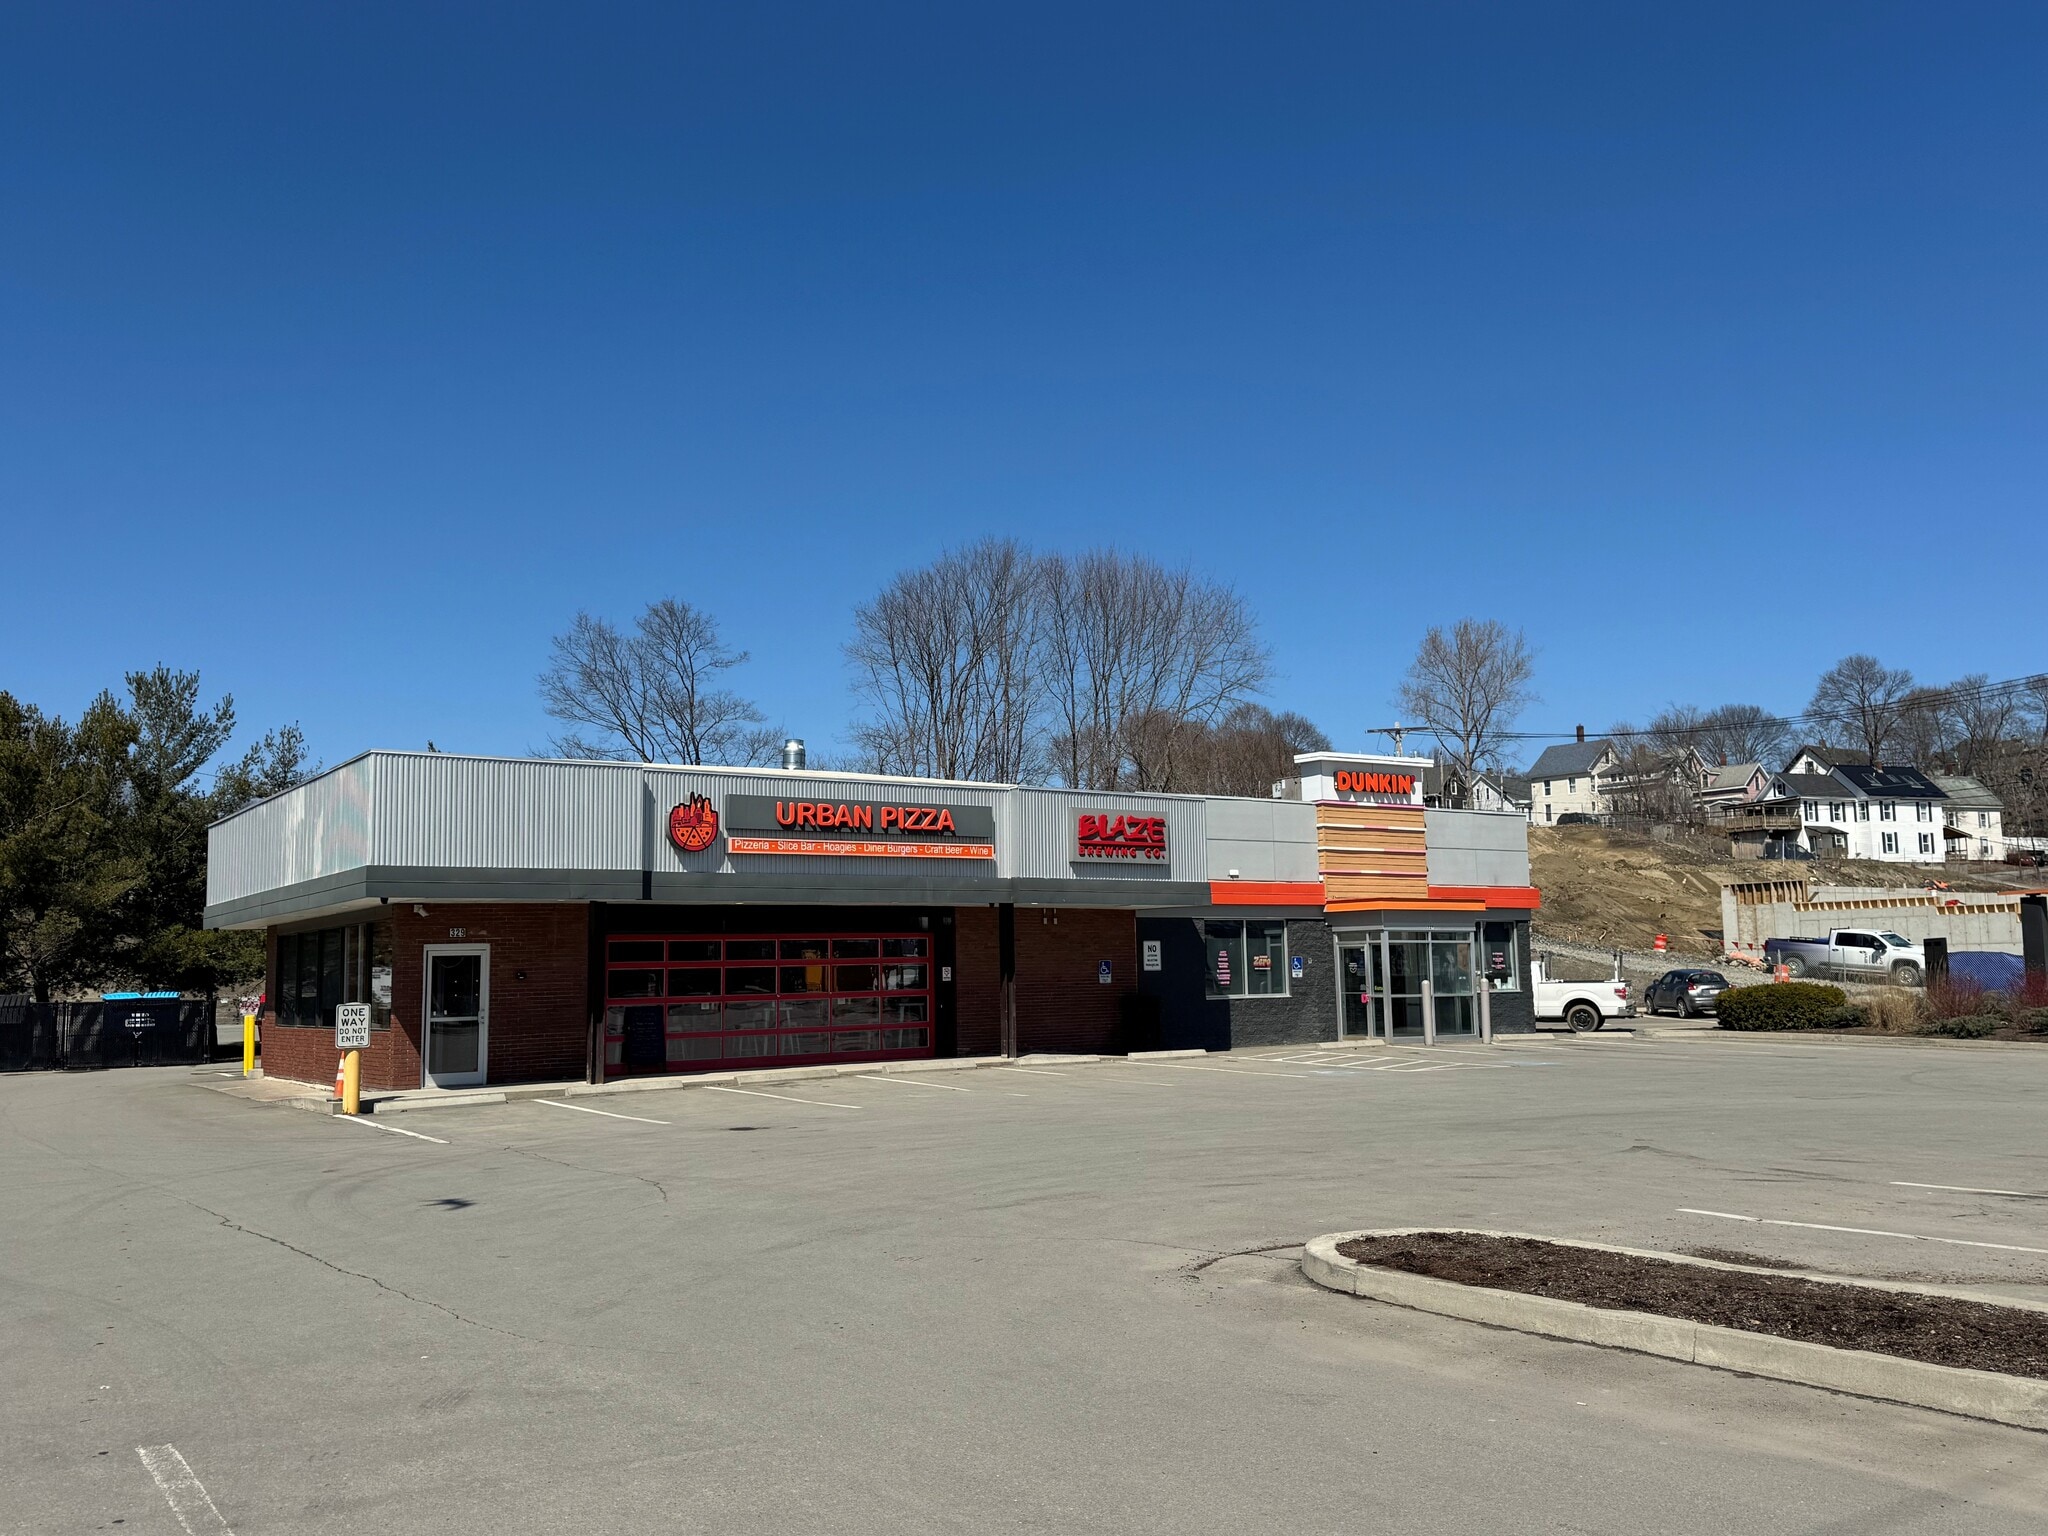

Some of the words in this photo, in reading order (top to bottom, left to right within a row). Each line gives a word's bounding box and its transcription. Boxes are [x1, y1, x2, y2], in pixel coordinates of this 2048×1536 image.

[1336, 770, 1415, 795] DUNKIN'
[776, 801, 873, 829] URBAN
[881, 806, 956, 831] PIZZA
[1078, 814, 1165, 842] BLAZE
[734, 839, 770, 850] Pizzeria
[777, 840, 799, 851] Slice
[800, 840, 816, 851] Bar
[823, 841, 857, 854] Hoagies
[863, 843, 885, 853] Diner
[887, 844, 918, 855] Burgers
[924, 845, 943, 854] Craft
[945, 845, 963, 855] Beer
[969, 846, 989, 855] Wine
[1078, 846, 1137, 858] BREWING
[450, 928, 466, 937] 329
[1147, 944, 1157, 953] NO
[342, 1008, 366, 1017] ONE
[341, 1017, 366, 1027] WAY
[341, 1035, 365, 1043] ENTER
